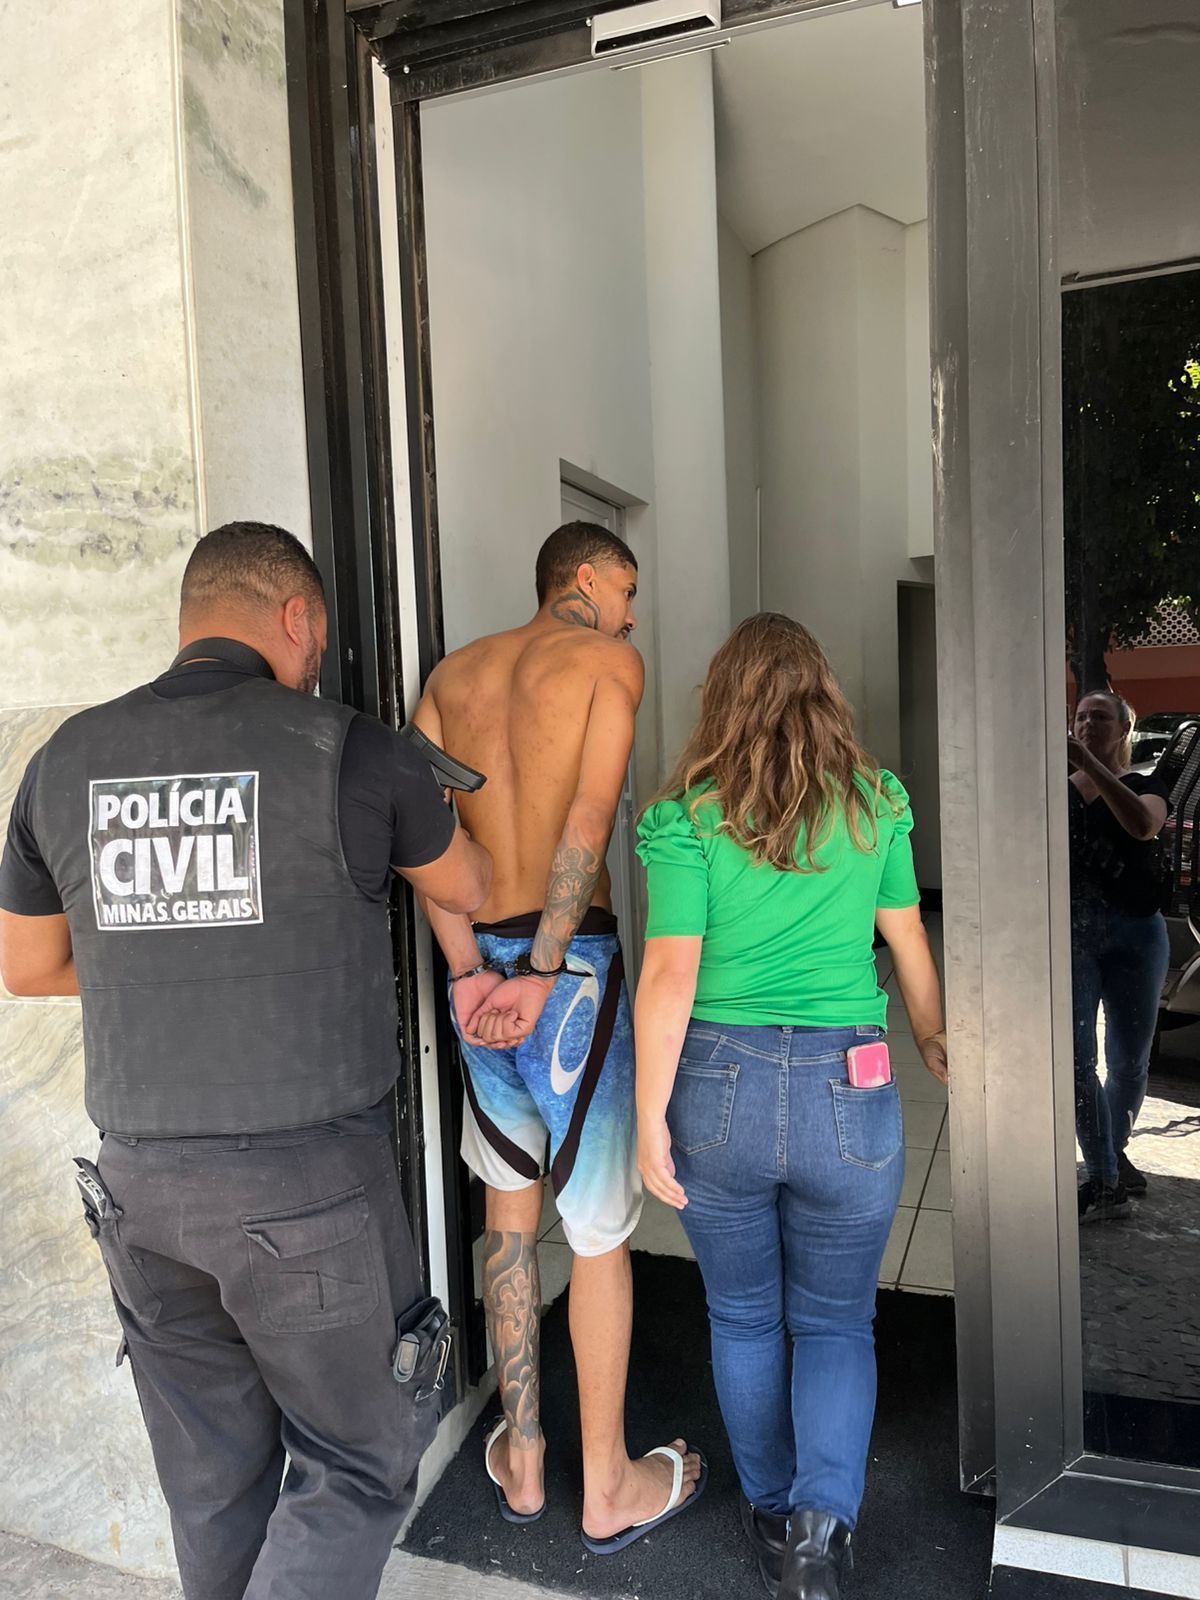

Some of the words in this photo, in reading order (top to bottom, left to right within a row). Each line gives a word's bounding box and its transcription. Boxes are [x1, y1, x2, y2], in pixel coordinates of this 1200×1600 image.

[98, 782, 247, 830] POLÍCIA
[100, 835, 249, 896] CIVIL
[102, 902, 168, 924] MINAS
[172, 898, 253, 921] GERAIS
